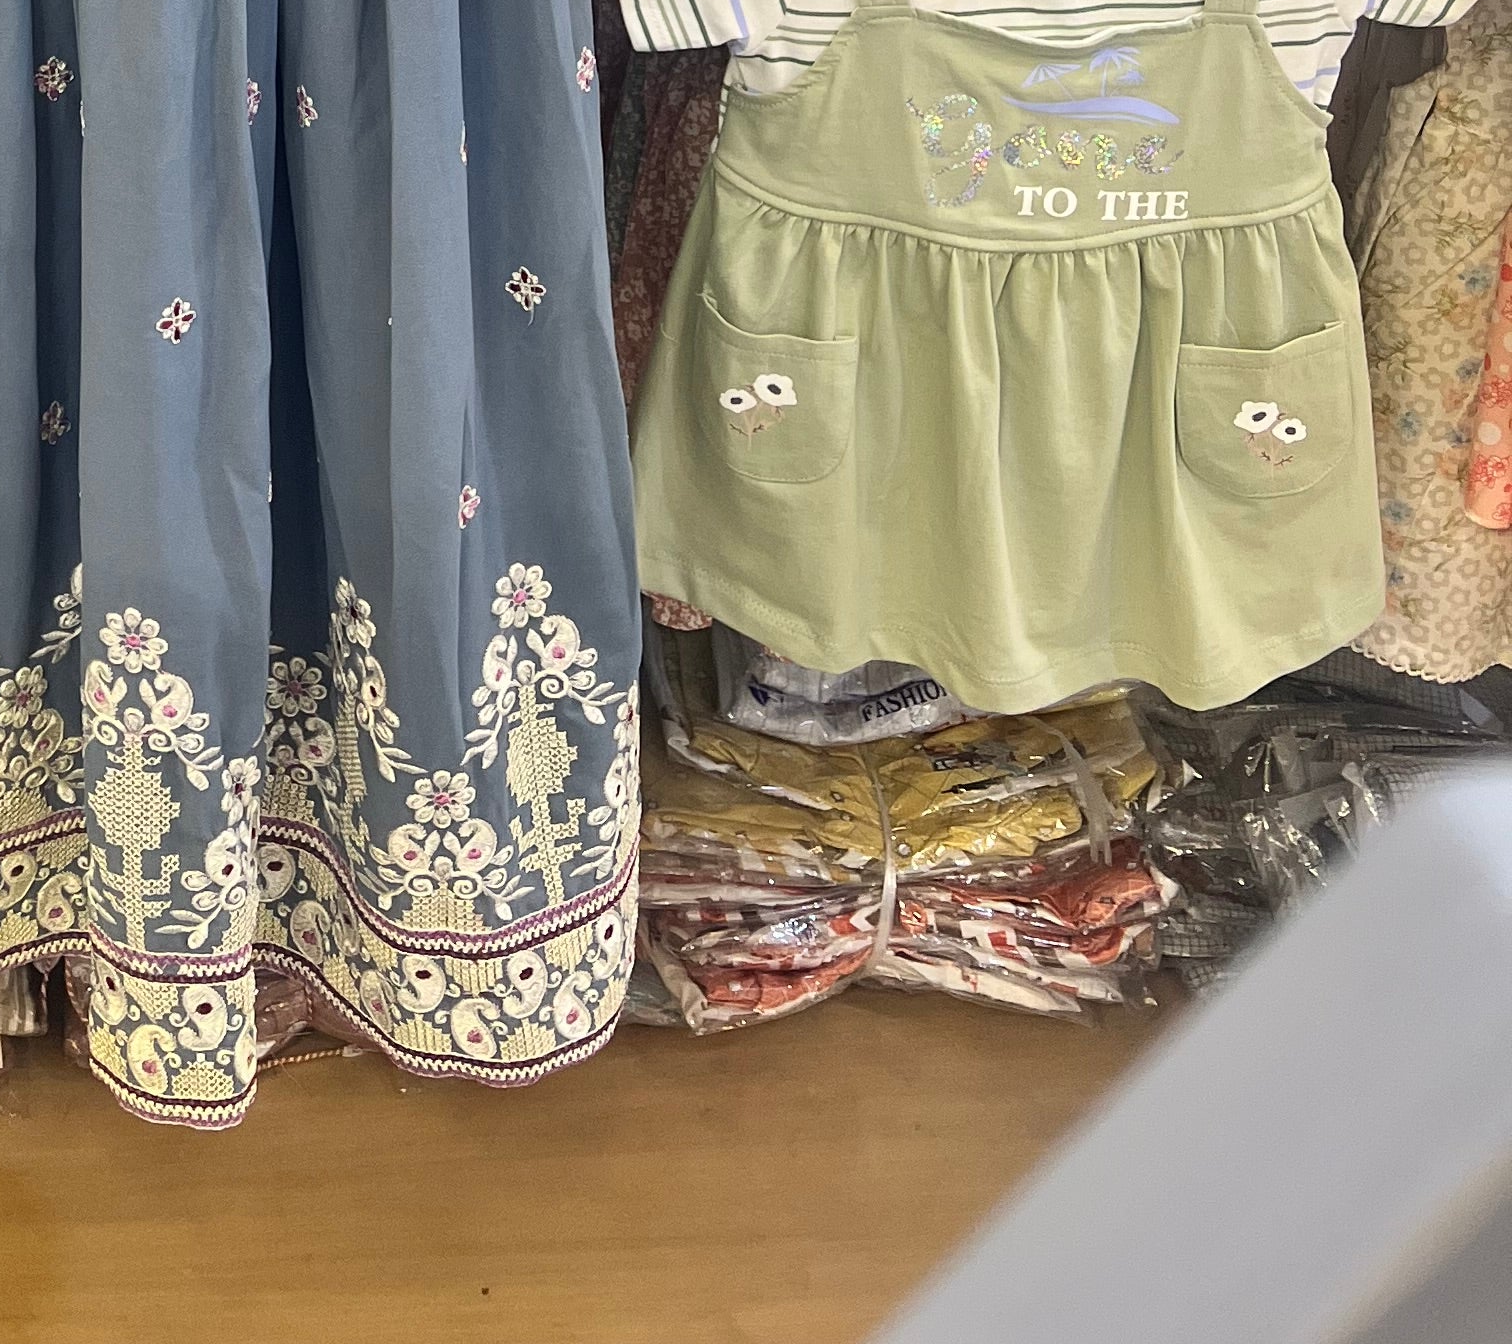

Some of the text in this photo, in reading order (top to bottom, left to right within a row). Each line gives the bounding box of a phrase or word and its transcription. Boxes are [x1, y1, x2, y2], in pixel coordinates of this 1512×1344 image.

[1013, 185, 1190, 222] TO THE
[860, 677, 948, 722] FASHIO
